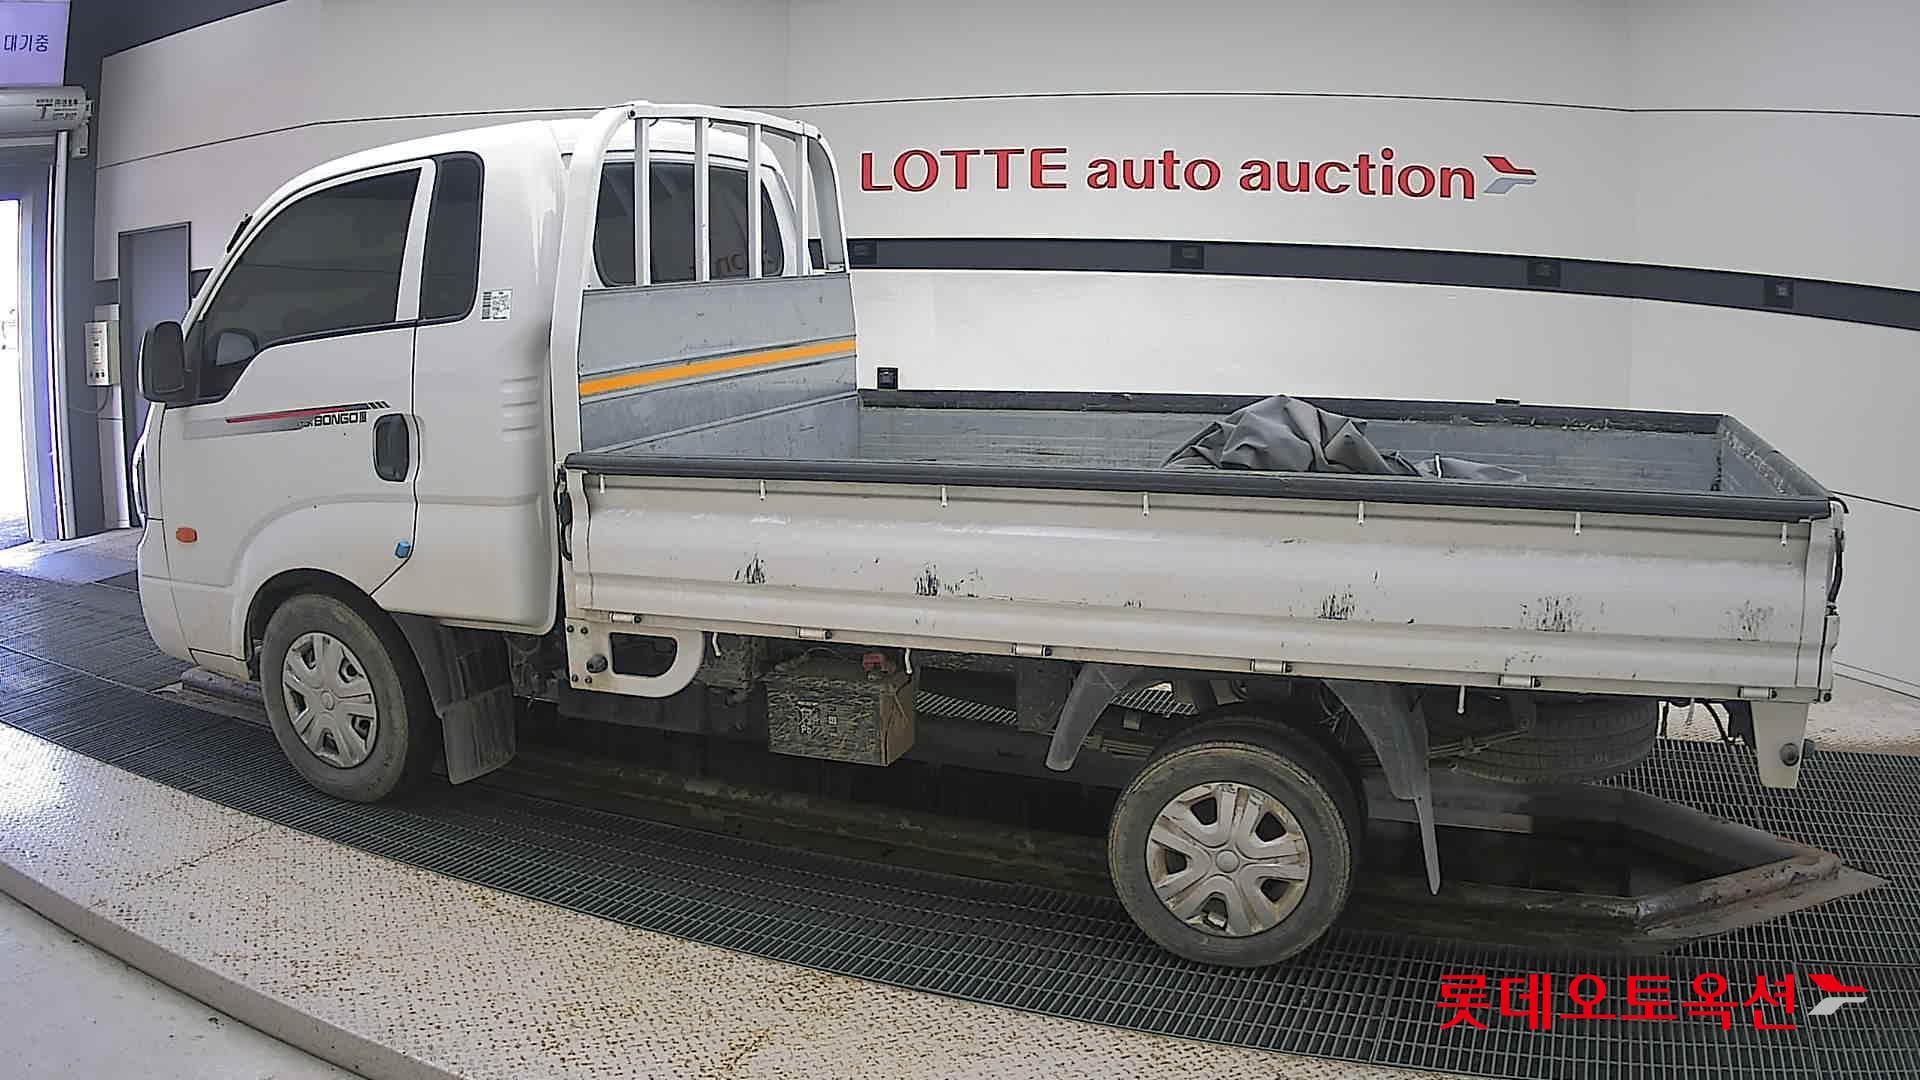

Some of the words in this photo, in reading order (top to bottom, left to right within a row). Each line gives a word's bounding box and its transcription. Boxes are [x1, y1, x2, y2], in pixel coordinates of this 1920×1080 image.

[4, 34, 49, 52] 대기중
[860, 147, 1067, 192] LOTTE
[1087, 150, 1221, 191] auto
[1239, 148, 1477, 200] auction
